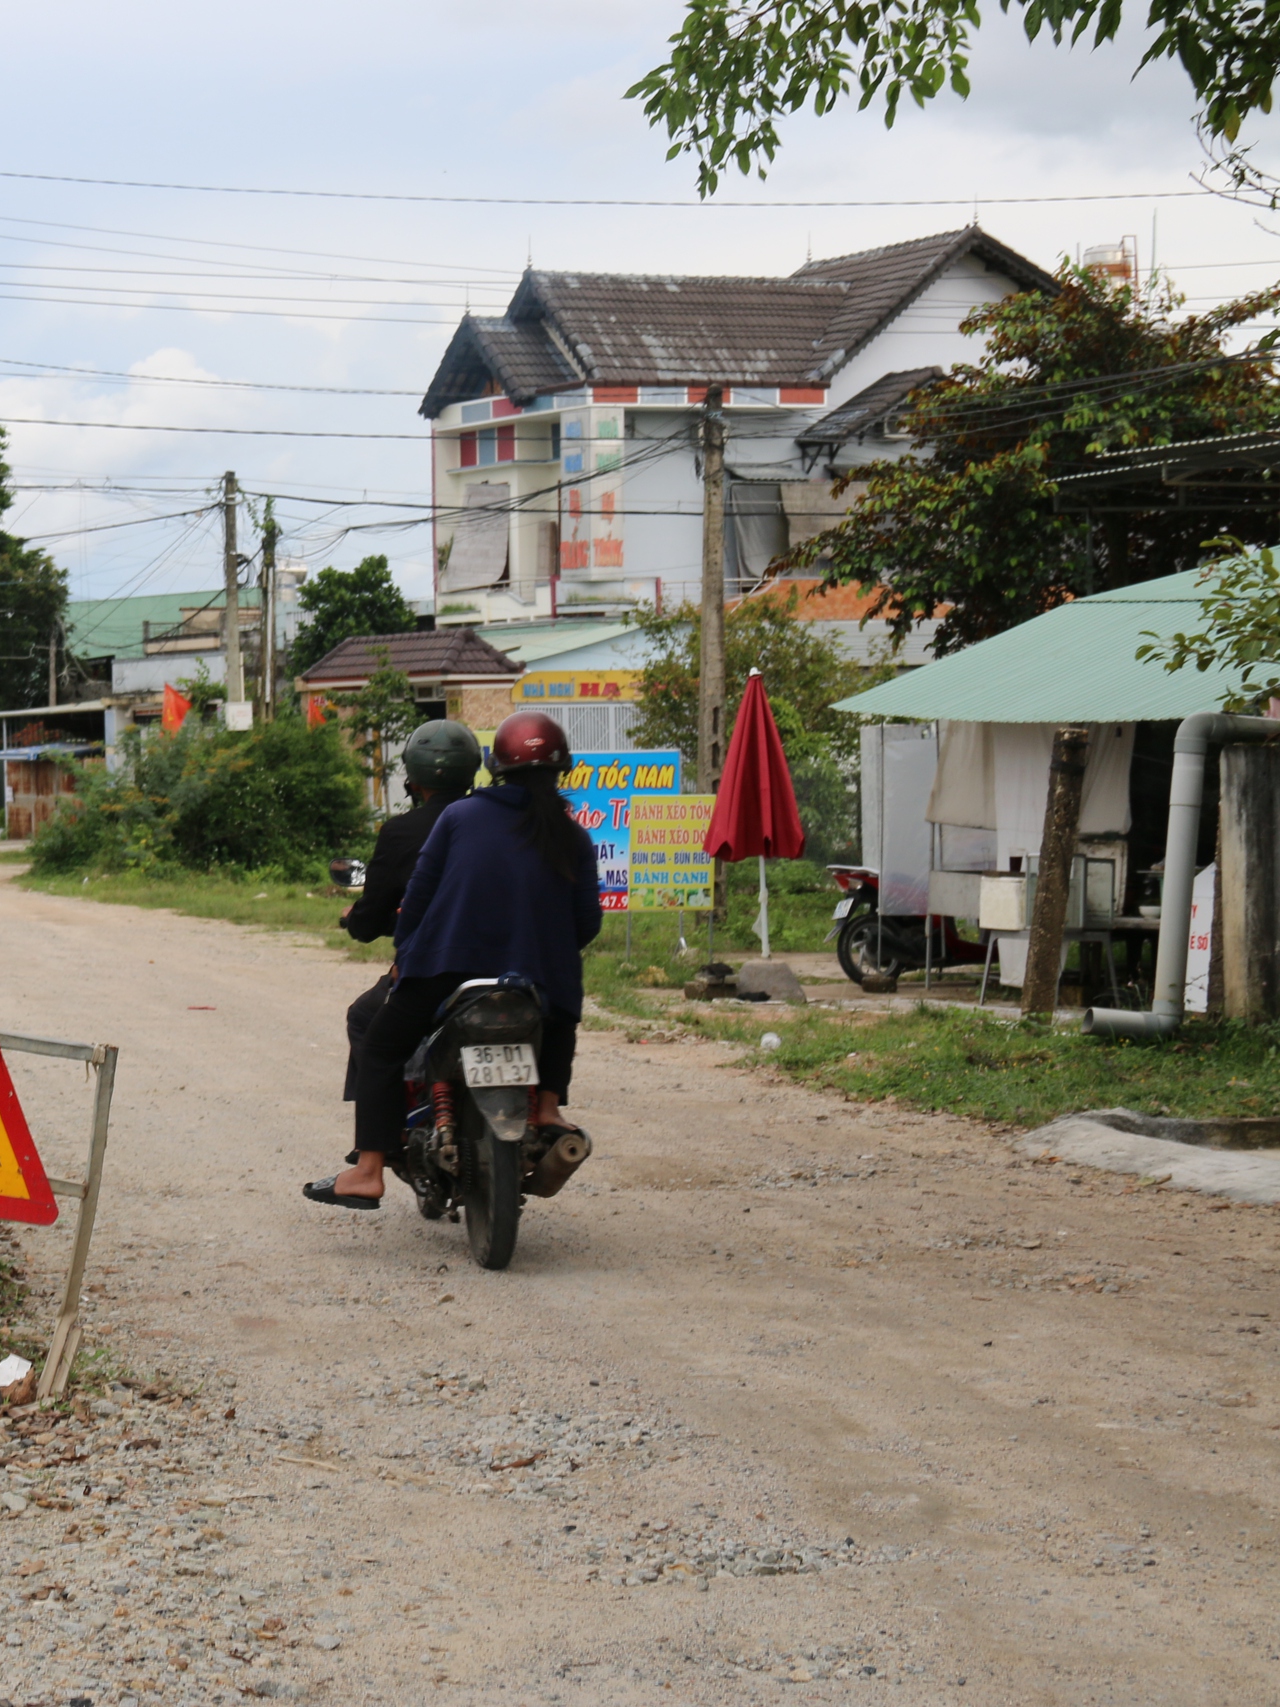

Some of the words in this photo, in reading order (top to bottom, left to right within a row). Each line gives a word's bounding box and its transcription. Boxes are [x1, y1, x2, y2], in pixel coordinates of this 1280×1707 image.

[596, 760, 631, 789] TÓC
[633, 764, 675, 789] NAM
[566, 801, 607, 829] ảo
[634, 801, 663, 820] BÁNH
[637, 825, 667, 844] BÁNH
[632, 849, 648, 864] BÚN
[651, 852, 666, 864] CUA
[674, 849, 690, 864] BÚN
[634, 868, 669, 884] BÁNH
[673, 872, 708, 884] CANH
